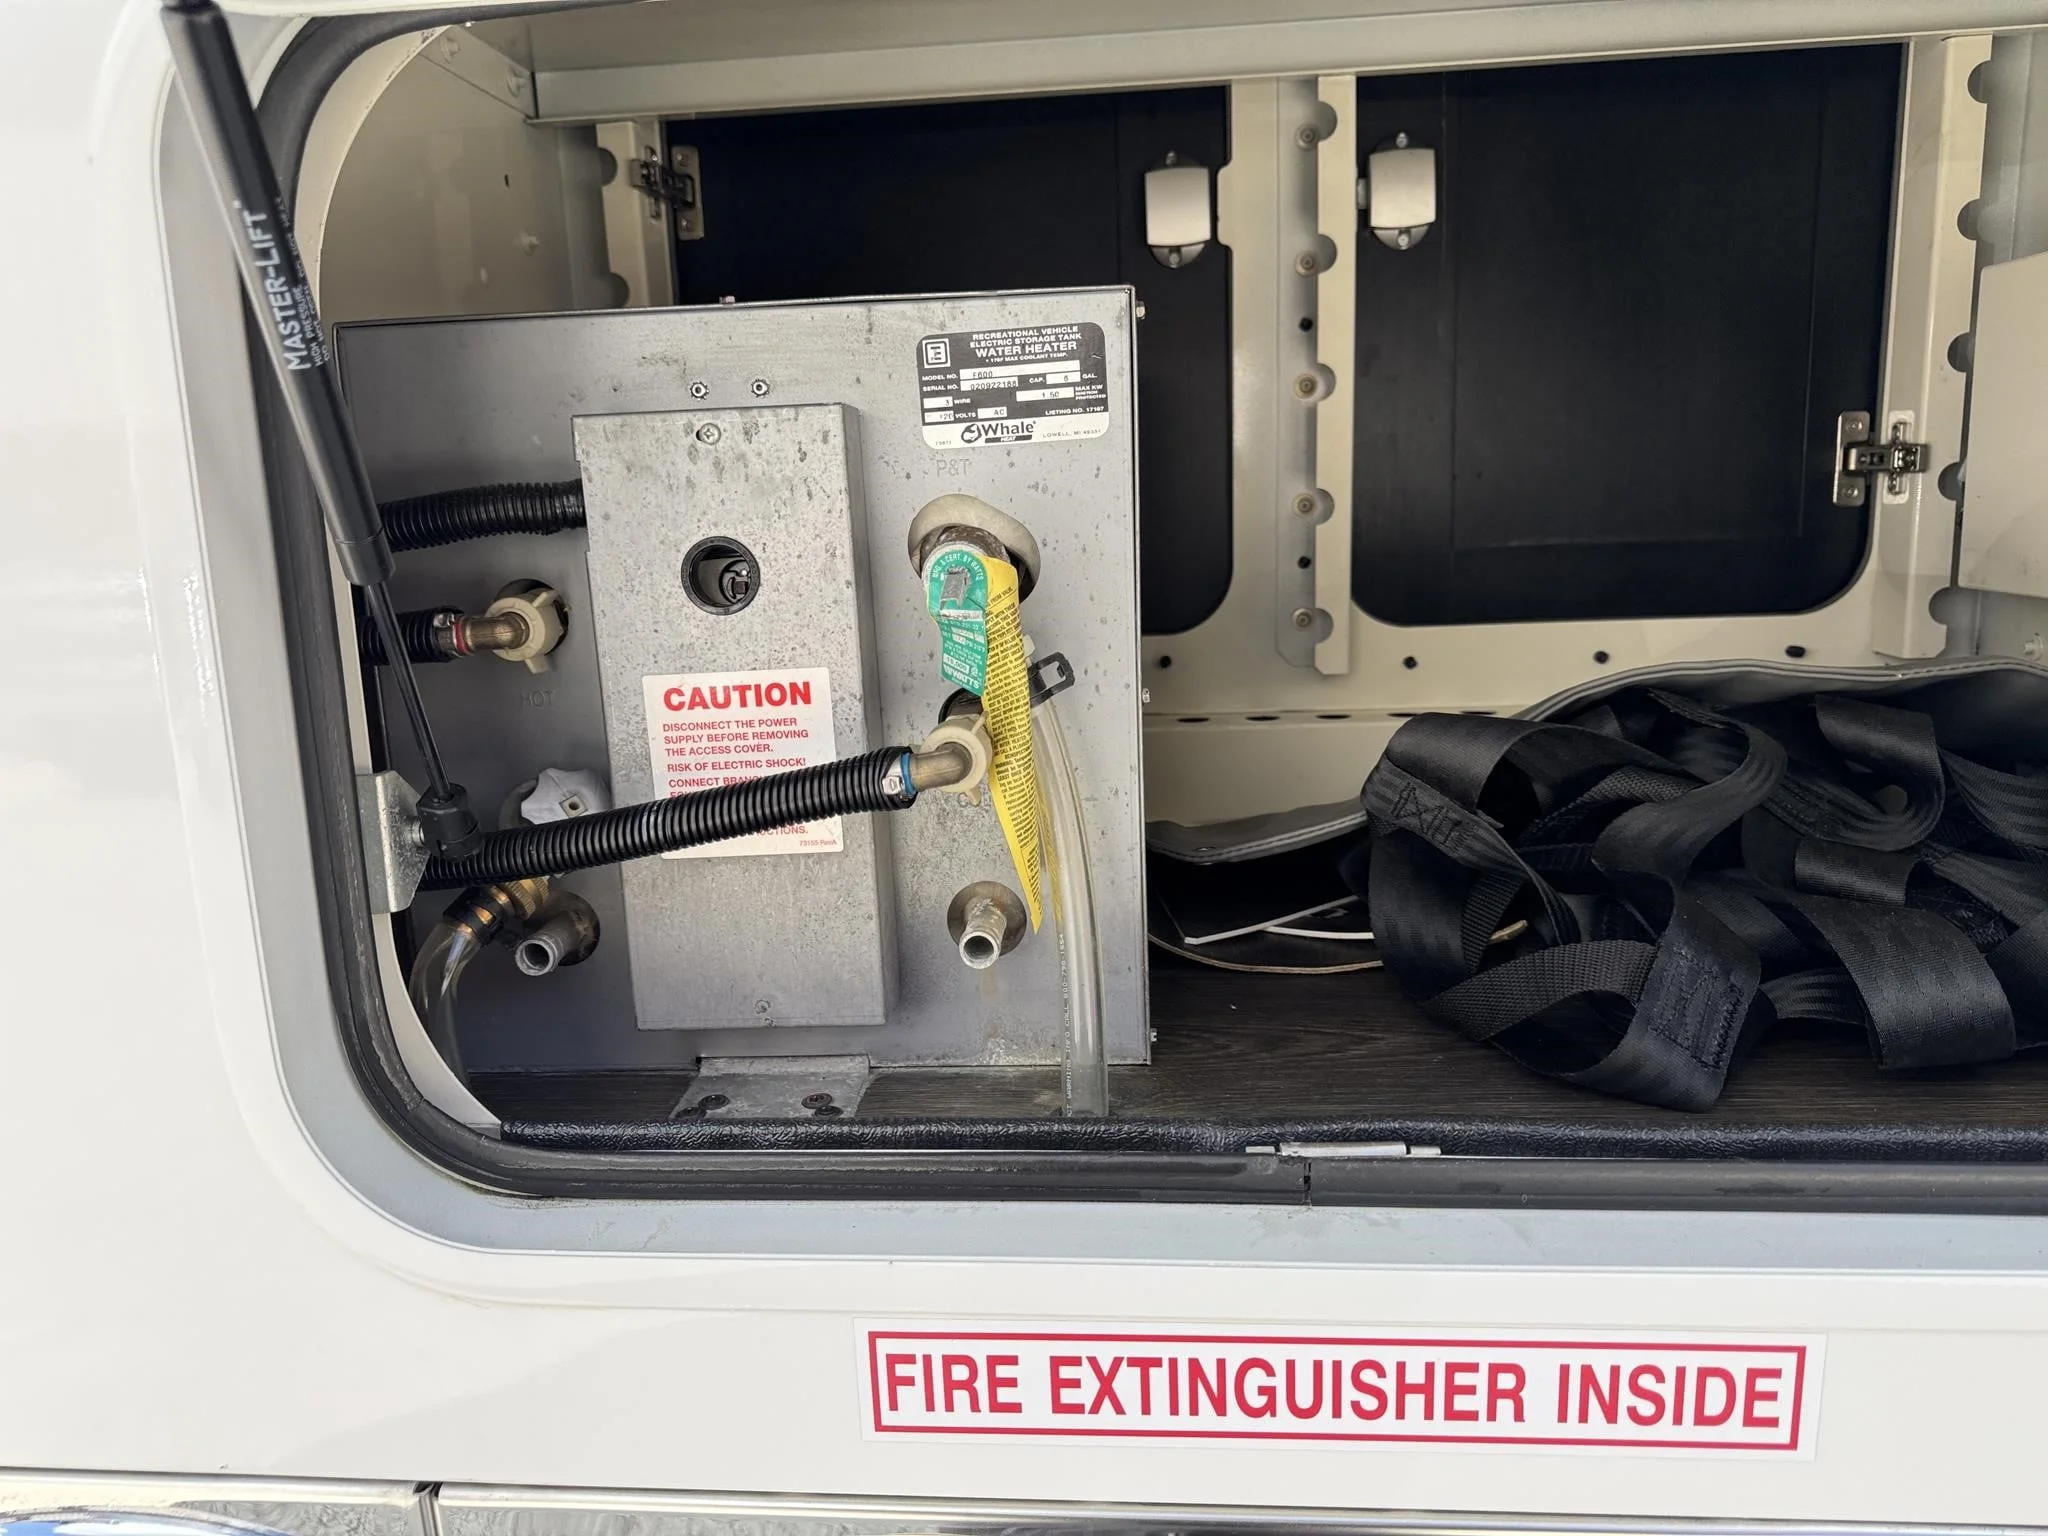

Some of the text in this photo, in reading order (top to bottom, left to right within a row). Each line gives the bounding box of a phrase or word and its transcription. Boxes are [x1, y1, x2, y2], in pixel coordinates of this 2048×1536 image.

[294, 287, 323, 366] HIGH PRESSURE
[973, 326, 1078, 340] RECREATIONAL VEHICLE
[970, 339, 1012, 348] ELECTRIC
[1015, 336, 1055, 344] STORAGE
[976, 342, 1077, 358] WATER HEATER
[982, 422, 1034, 436] Whale
[937, 457, 970, 476] P&T
[664, 682, 812, 711] CAUTION
[663, 718, 797, 732] DISCONNECT THE POWER
[664, 730, 808, 744] SUPPLY BEFORE REMOVING
[666, 744, 773, 756] THE ACCESS COVER.
[668, 758, 806, 772] RISK OF ELECTRIC SHOCK!
[669, 778, 719, 788] CONNECT
[886, 1353, 1782, 1428] FIRE EXTINGUISHER INSIDE
